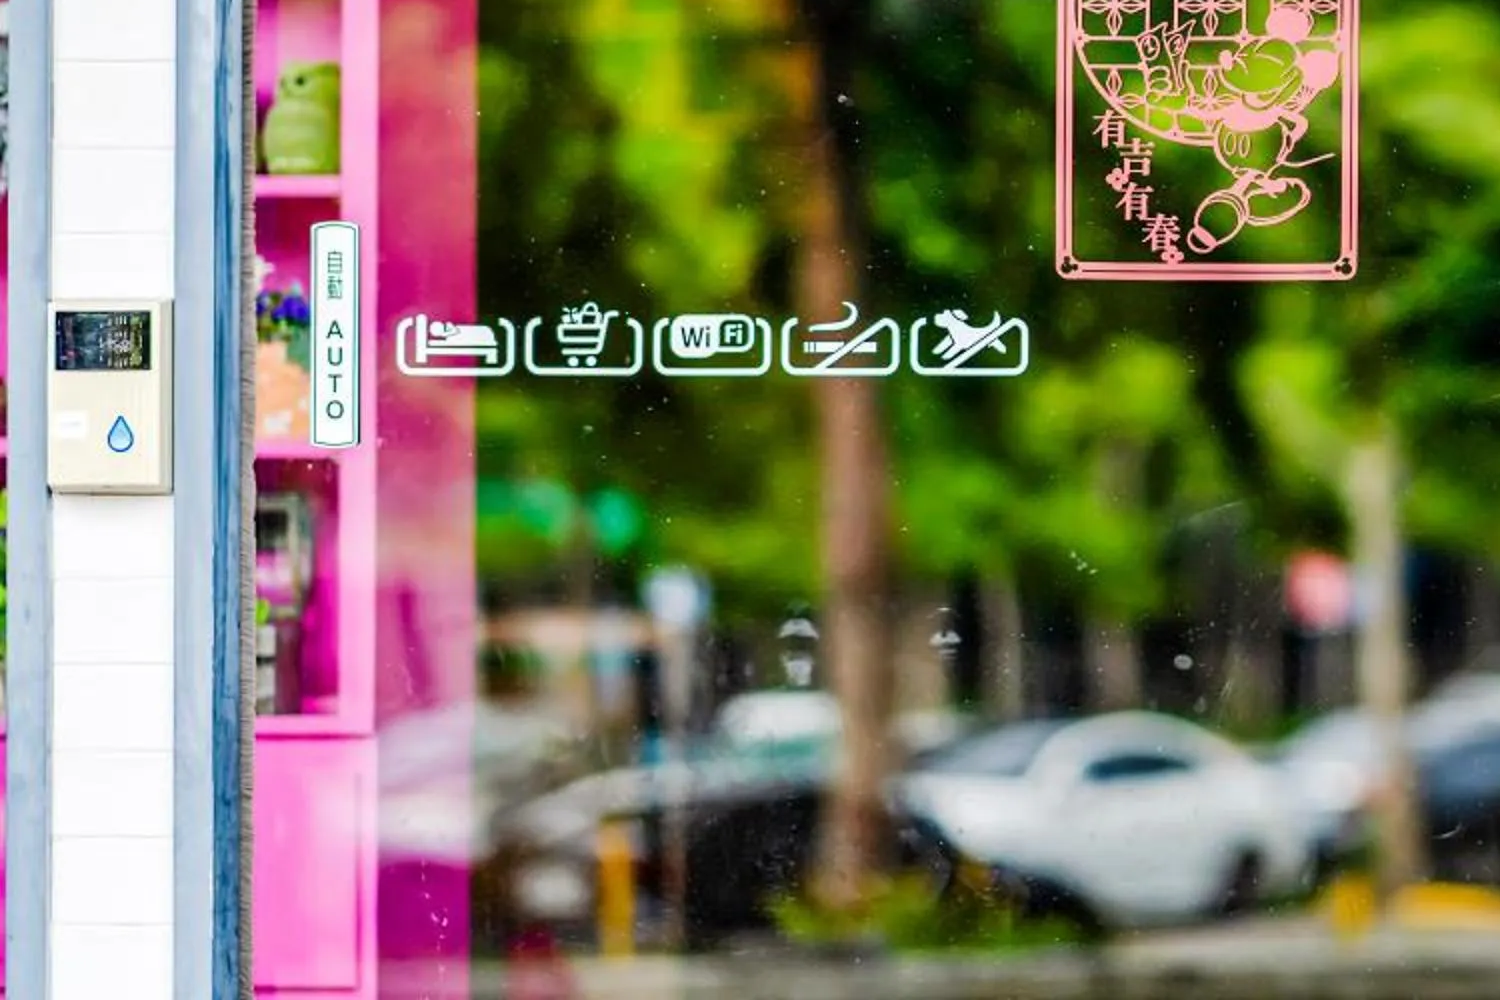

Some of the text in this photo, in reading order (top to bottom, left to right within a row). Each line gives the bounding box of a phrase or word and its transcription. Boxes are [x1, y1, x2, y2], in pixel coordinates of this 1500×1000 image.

[1092, 109, 1181, 253] 有吉有春
[326, 320, 344, 419] AUTO
